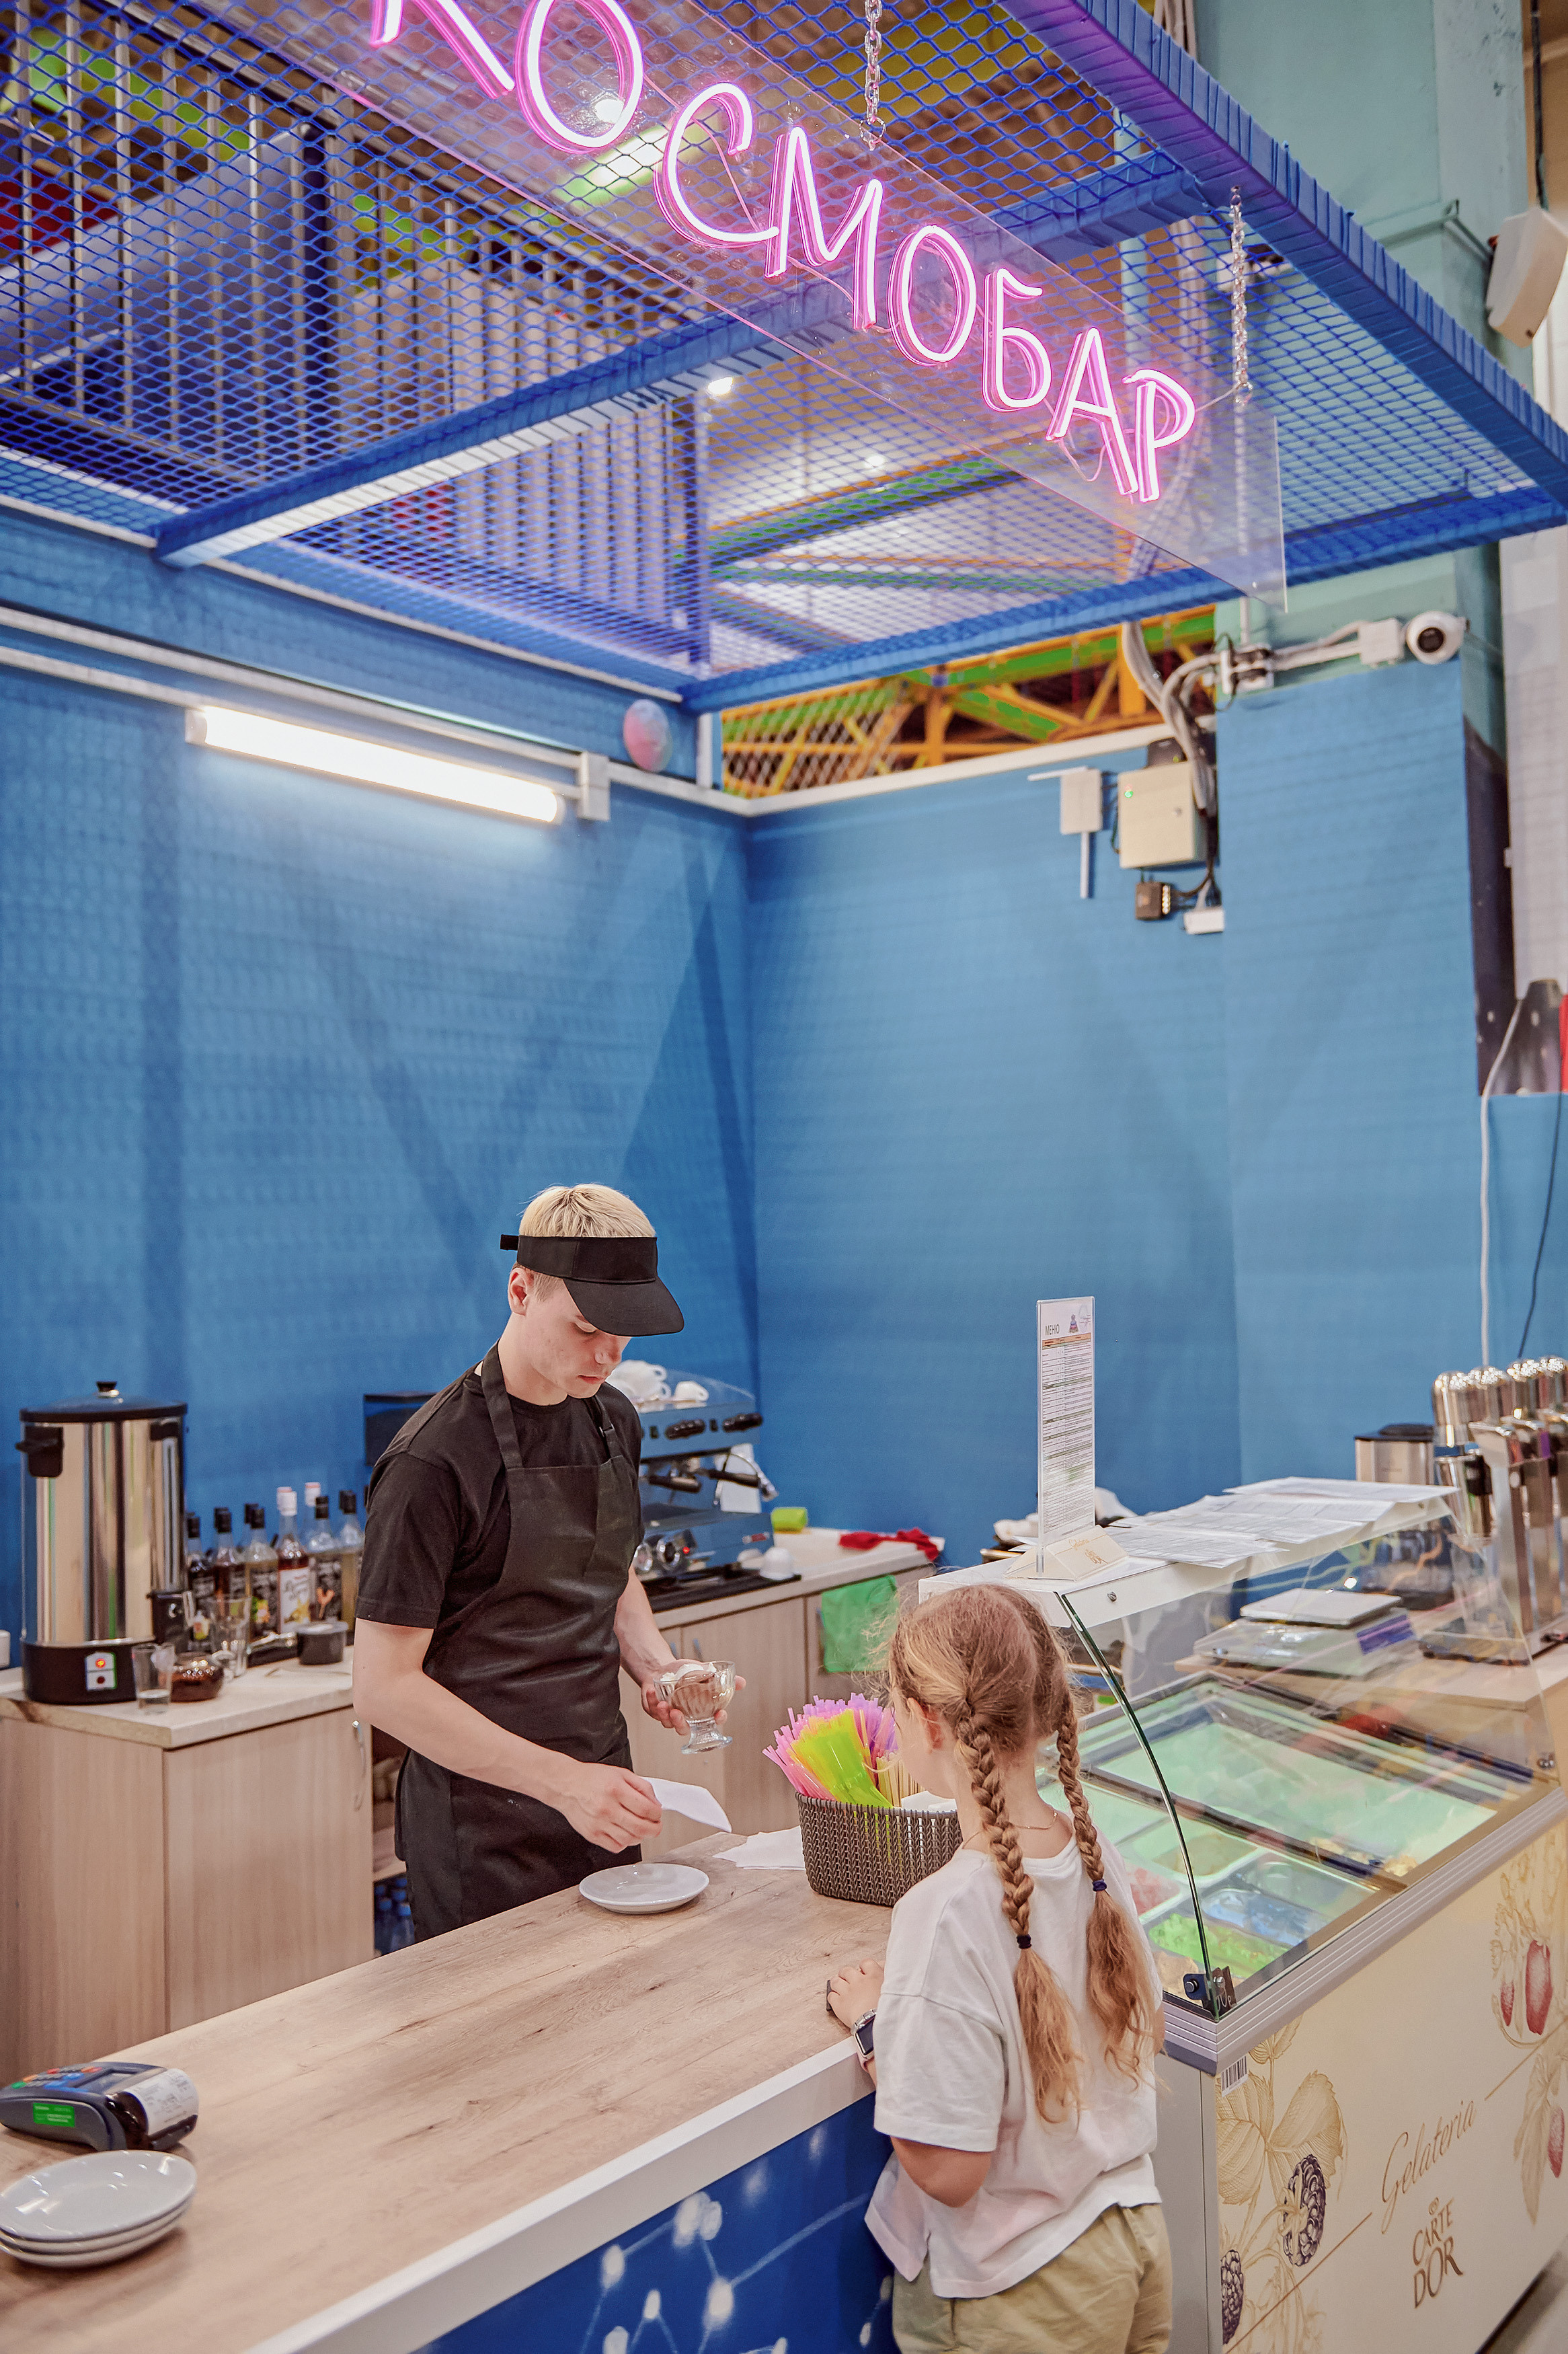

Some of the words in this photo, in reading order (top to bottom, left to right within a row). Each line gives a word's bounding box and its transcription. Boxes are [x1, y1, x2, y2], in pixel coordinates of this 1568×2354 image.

[1045, 1324, 1060, 1336] МЕНЮ
[1382, 2100, 1477, 2235] Gelateria
[1413, 2197, 1454, 2267] CARTE
